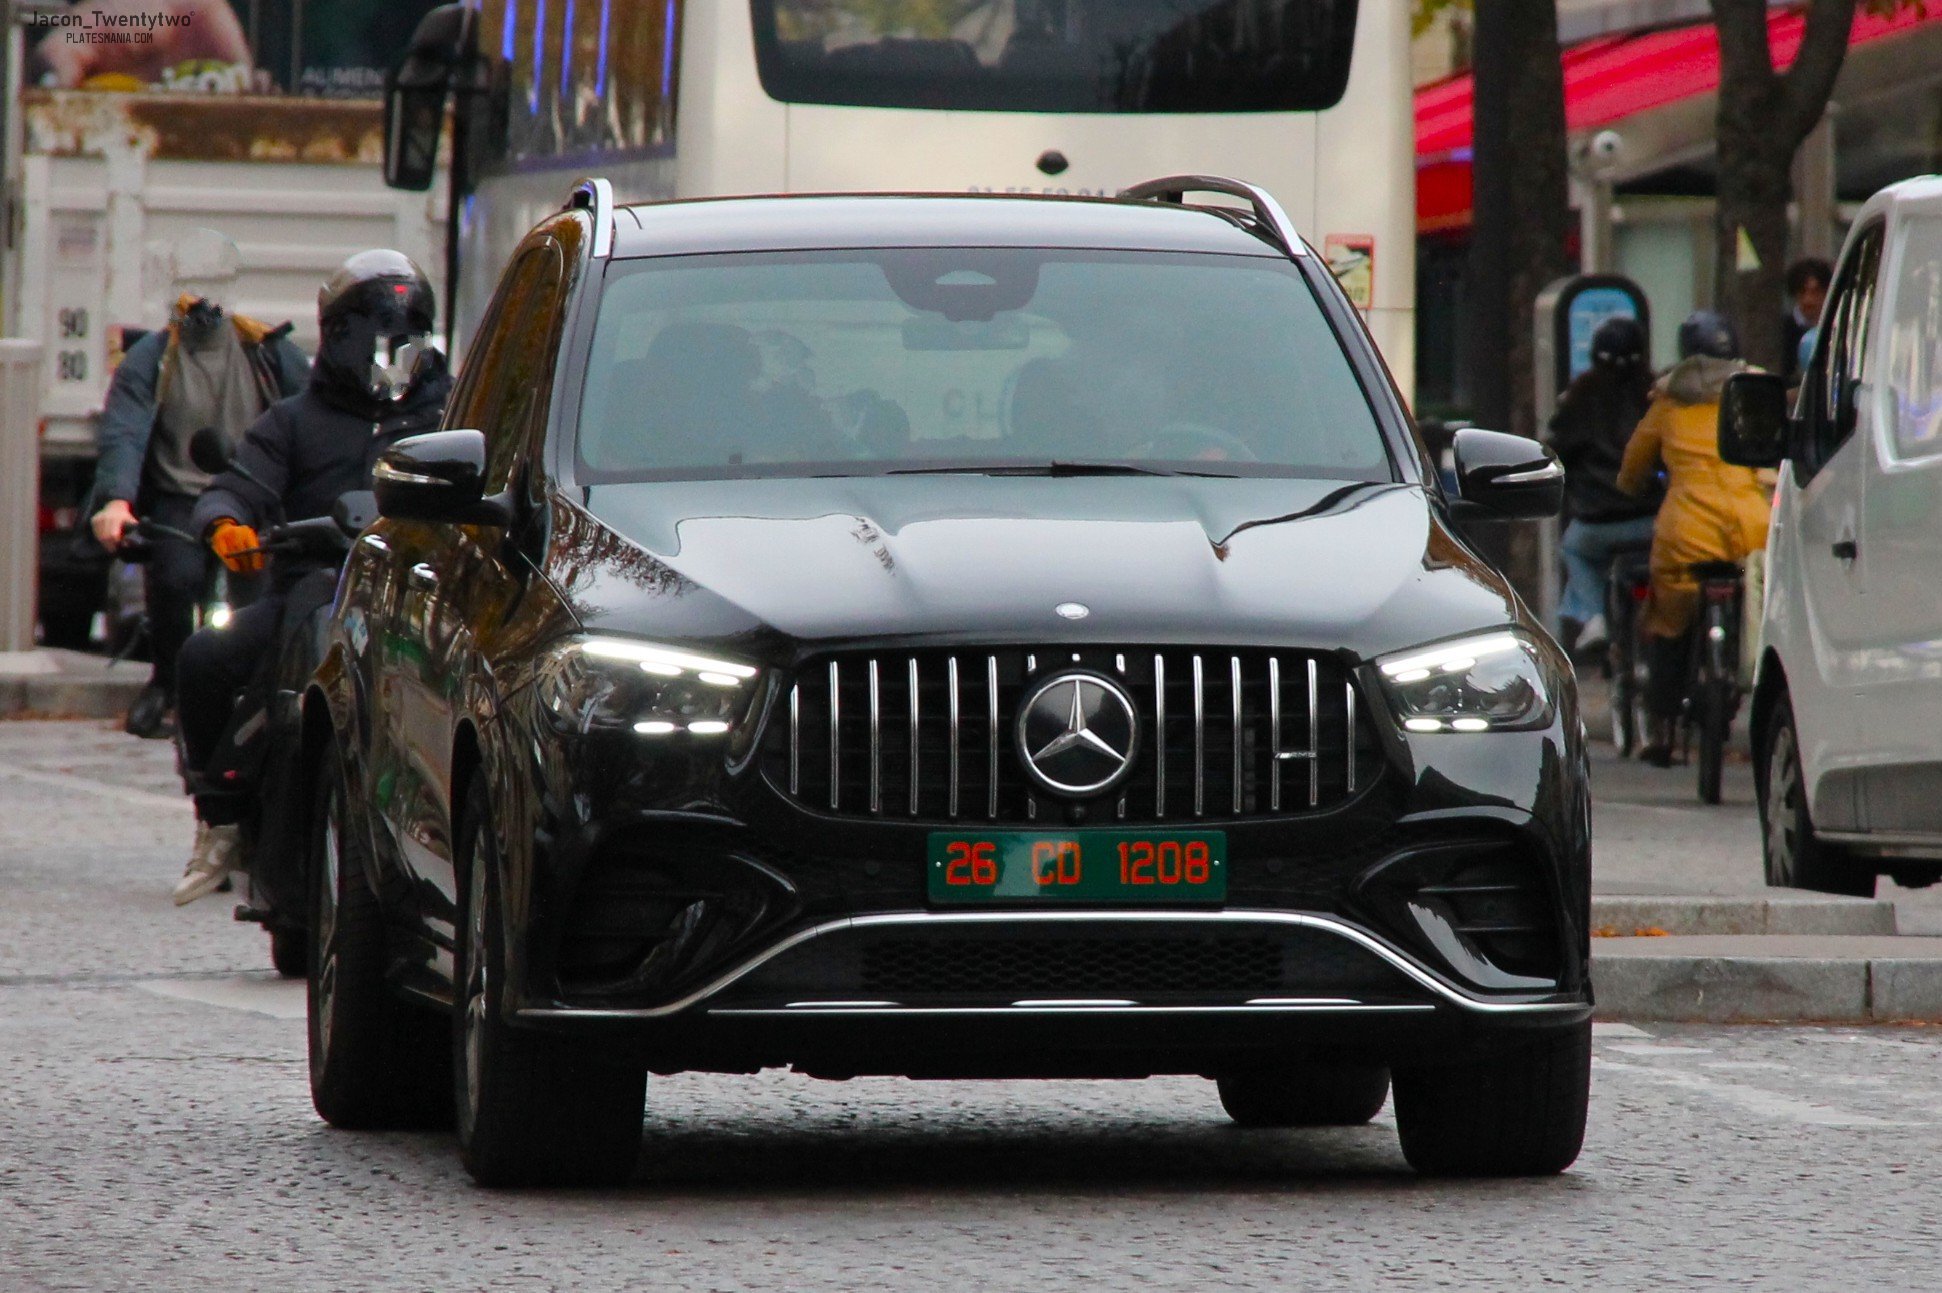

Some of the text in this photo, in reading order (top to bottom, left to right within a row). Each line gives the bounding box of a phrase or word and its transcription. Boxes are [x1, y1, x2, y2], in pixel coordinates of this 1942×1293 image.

[58, 307, 88, 338] 90
[58, 350, 88, 380] 80
[946, 841, 1209, 885] 26 CD 1208
